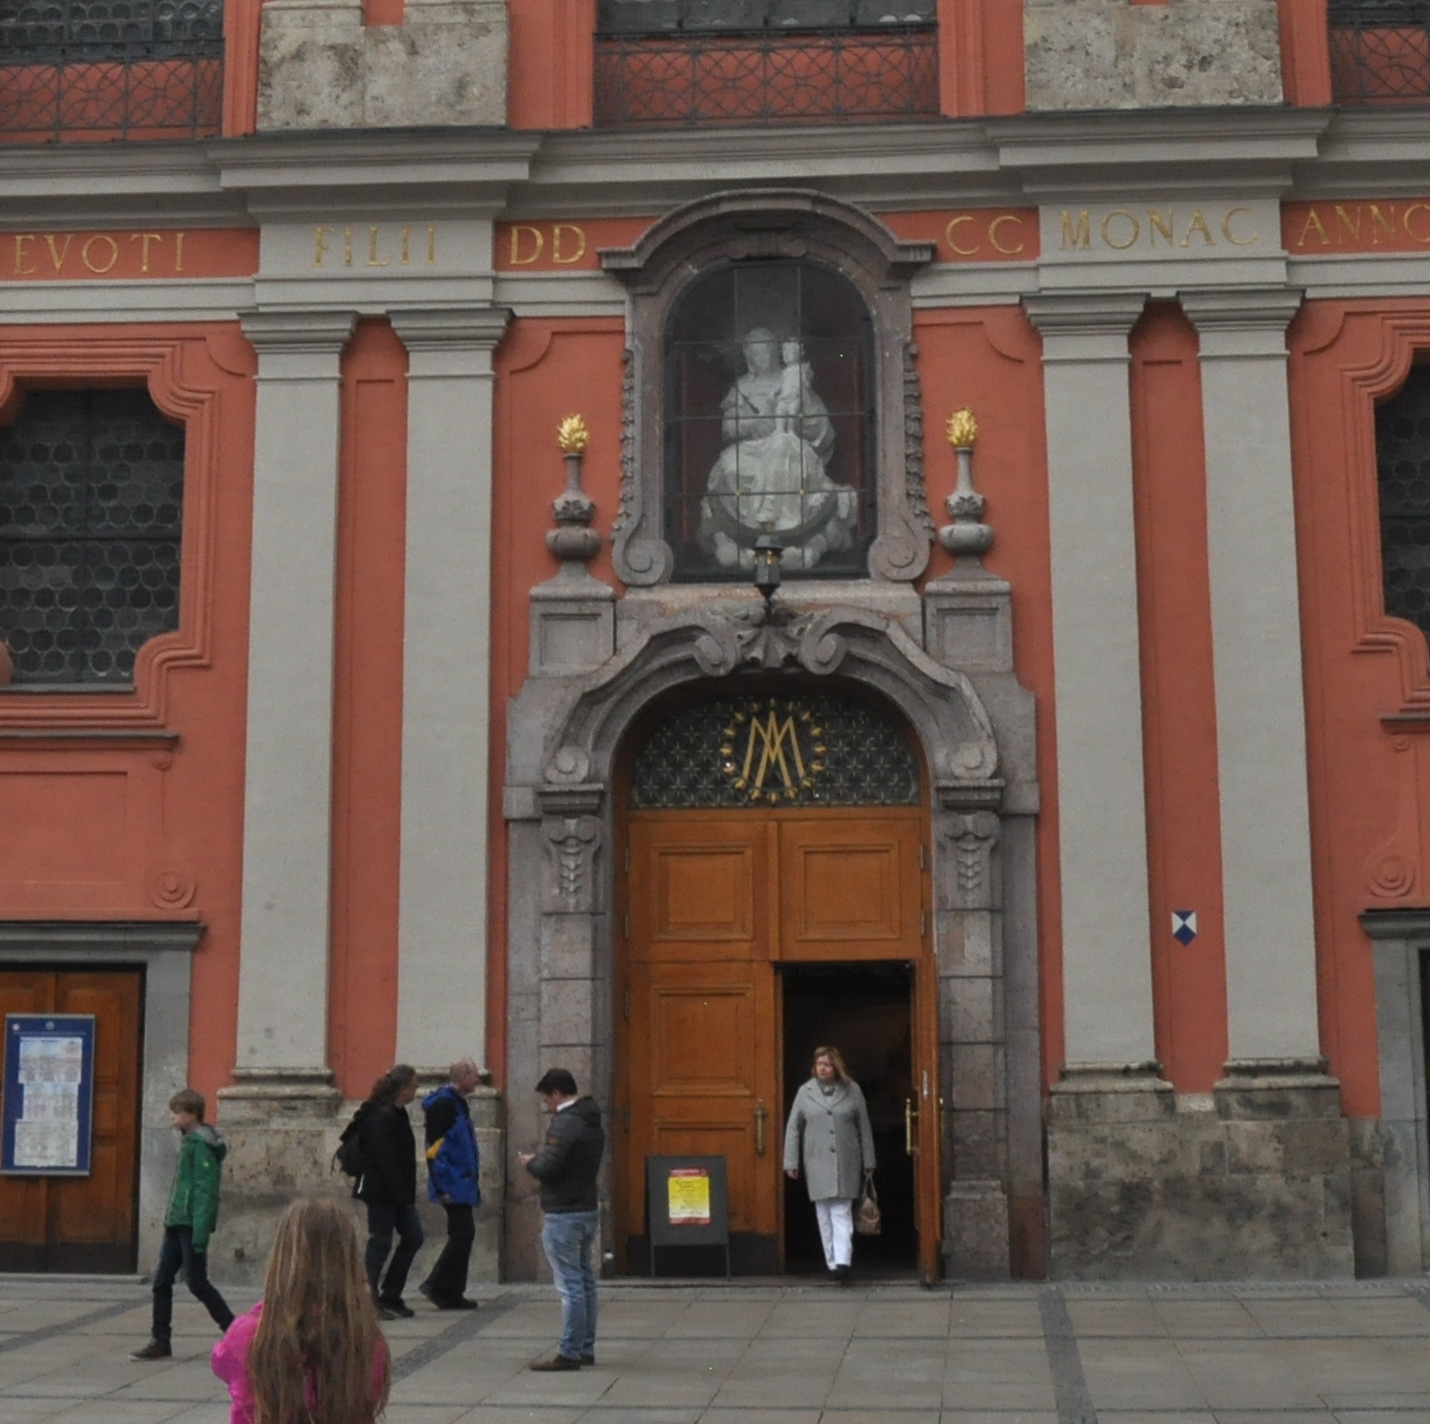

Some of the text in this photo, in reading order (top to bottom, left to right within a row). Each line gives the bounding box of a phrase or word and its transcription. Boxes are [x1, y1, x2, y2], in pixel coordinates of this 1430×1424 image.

[312, 225, 435, 268] FILII
[509, 225, 586, 266] DD
[945, 215, 1024, 255] CC
[1058, 206, 1259, 251] MONAC
